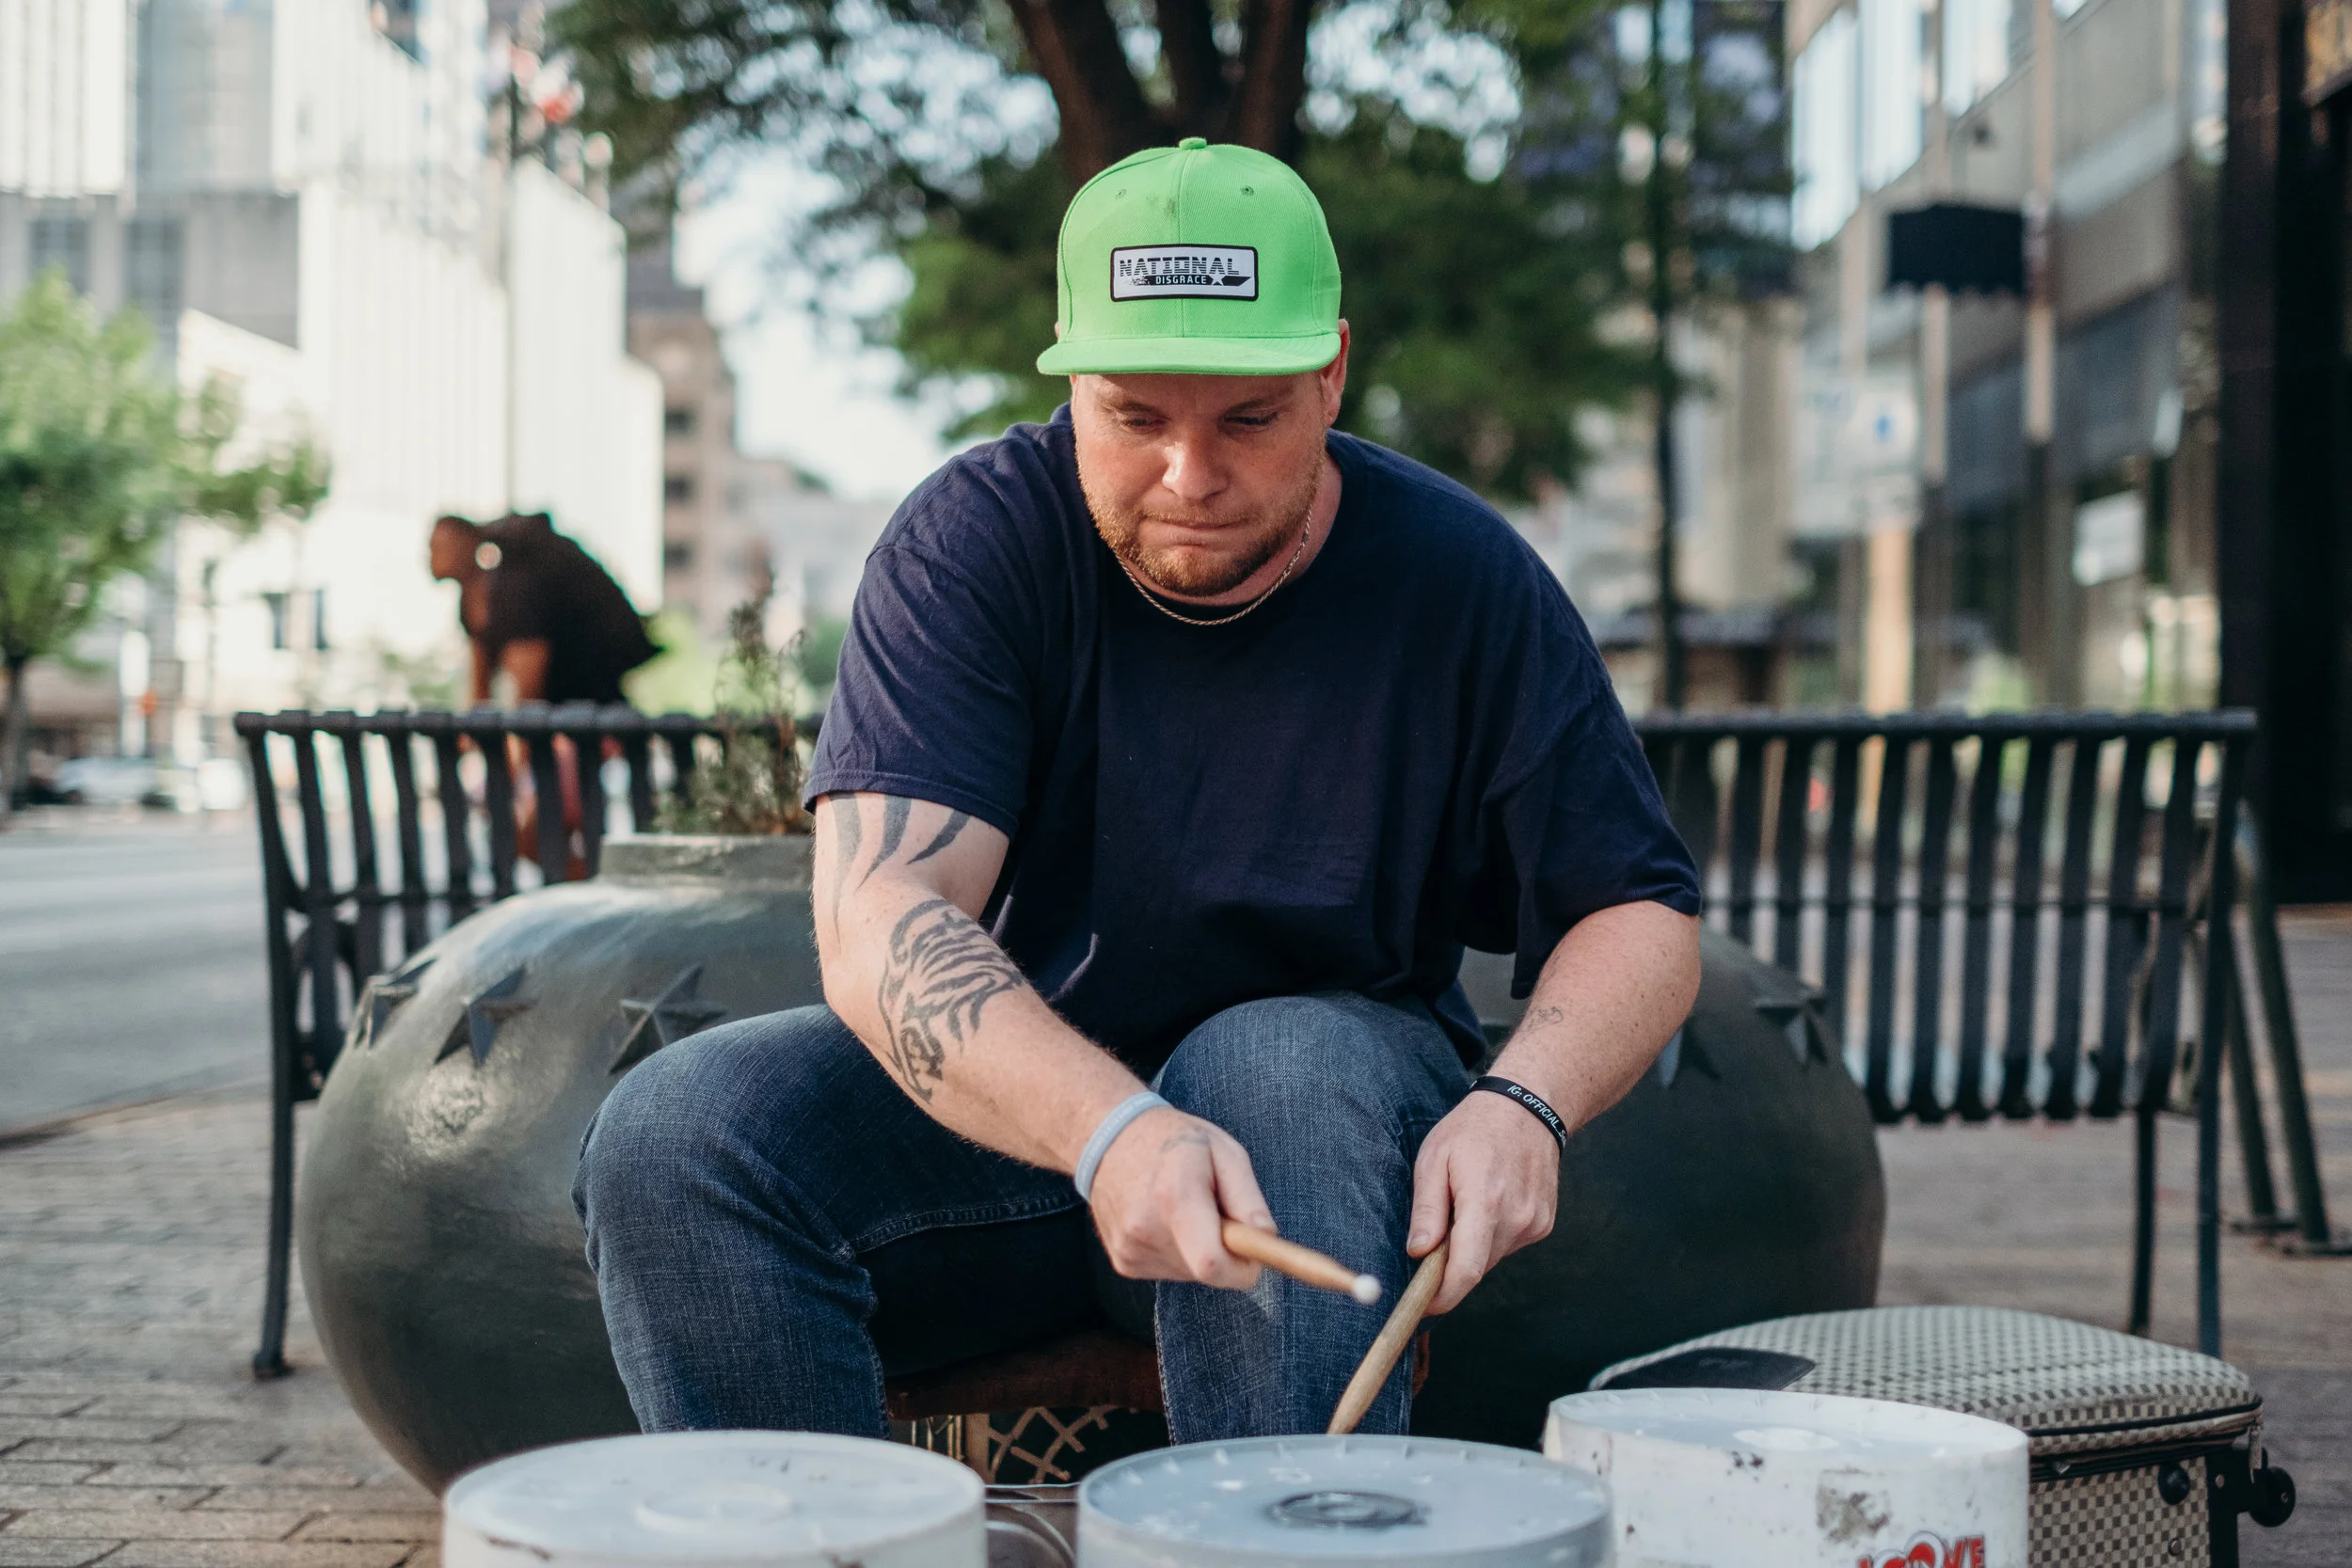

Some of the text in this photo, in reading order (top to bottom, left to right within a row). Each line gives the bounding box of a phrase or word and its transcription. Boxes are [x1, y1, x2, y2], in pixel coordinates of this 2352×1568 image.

[1120, 256, 1240, 277] NATIONAL
[1155, 275, 1207, 285] DISGRACE
[1507, 1085, 1523, 1097] IG:
